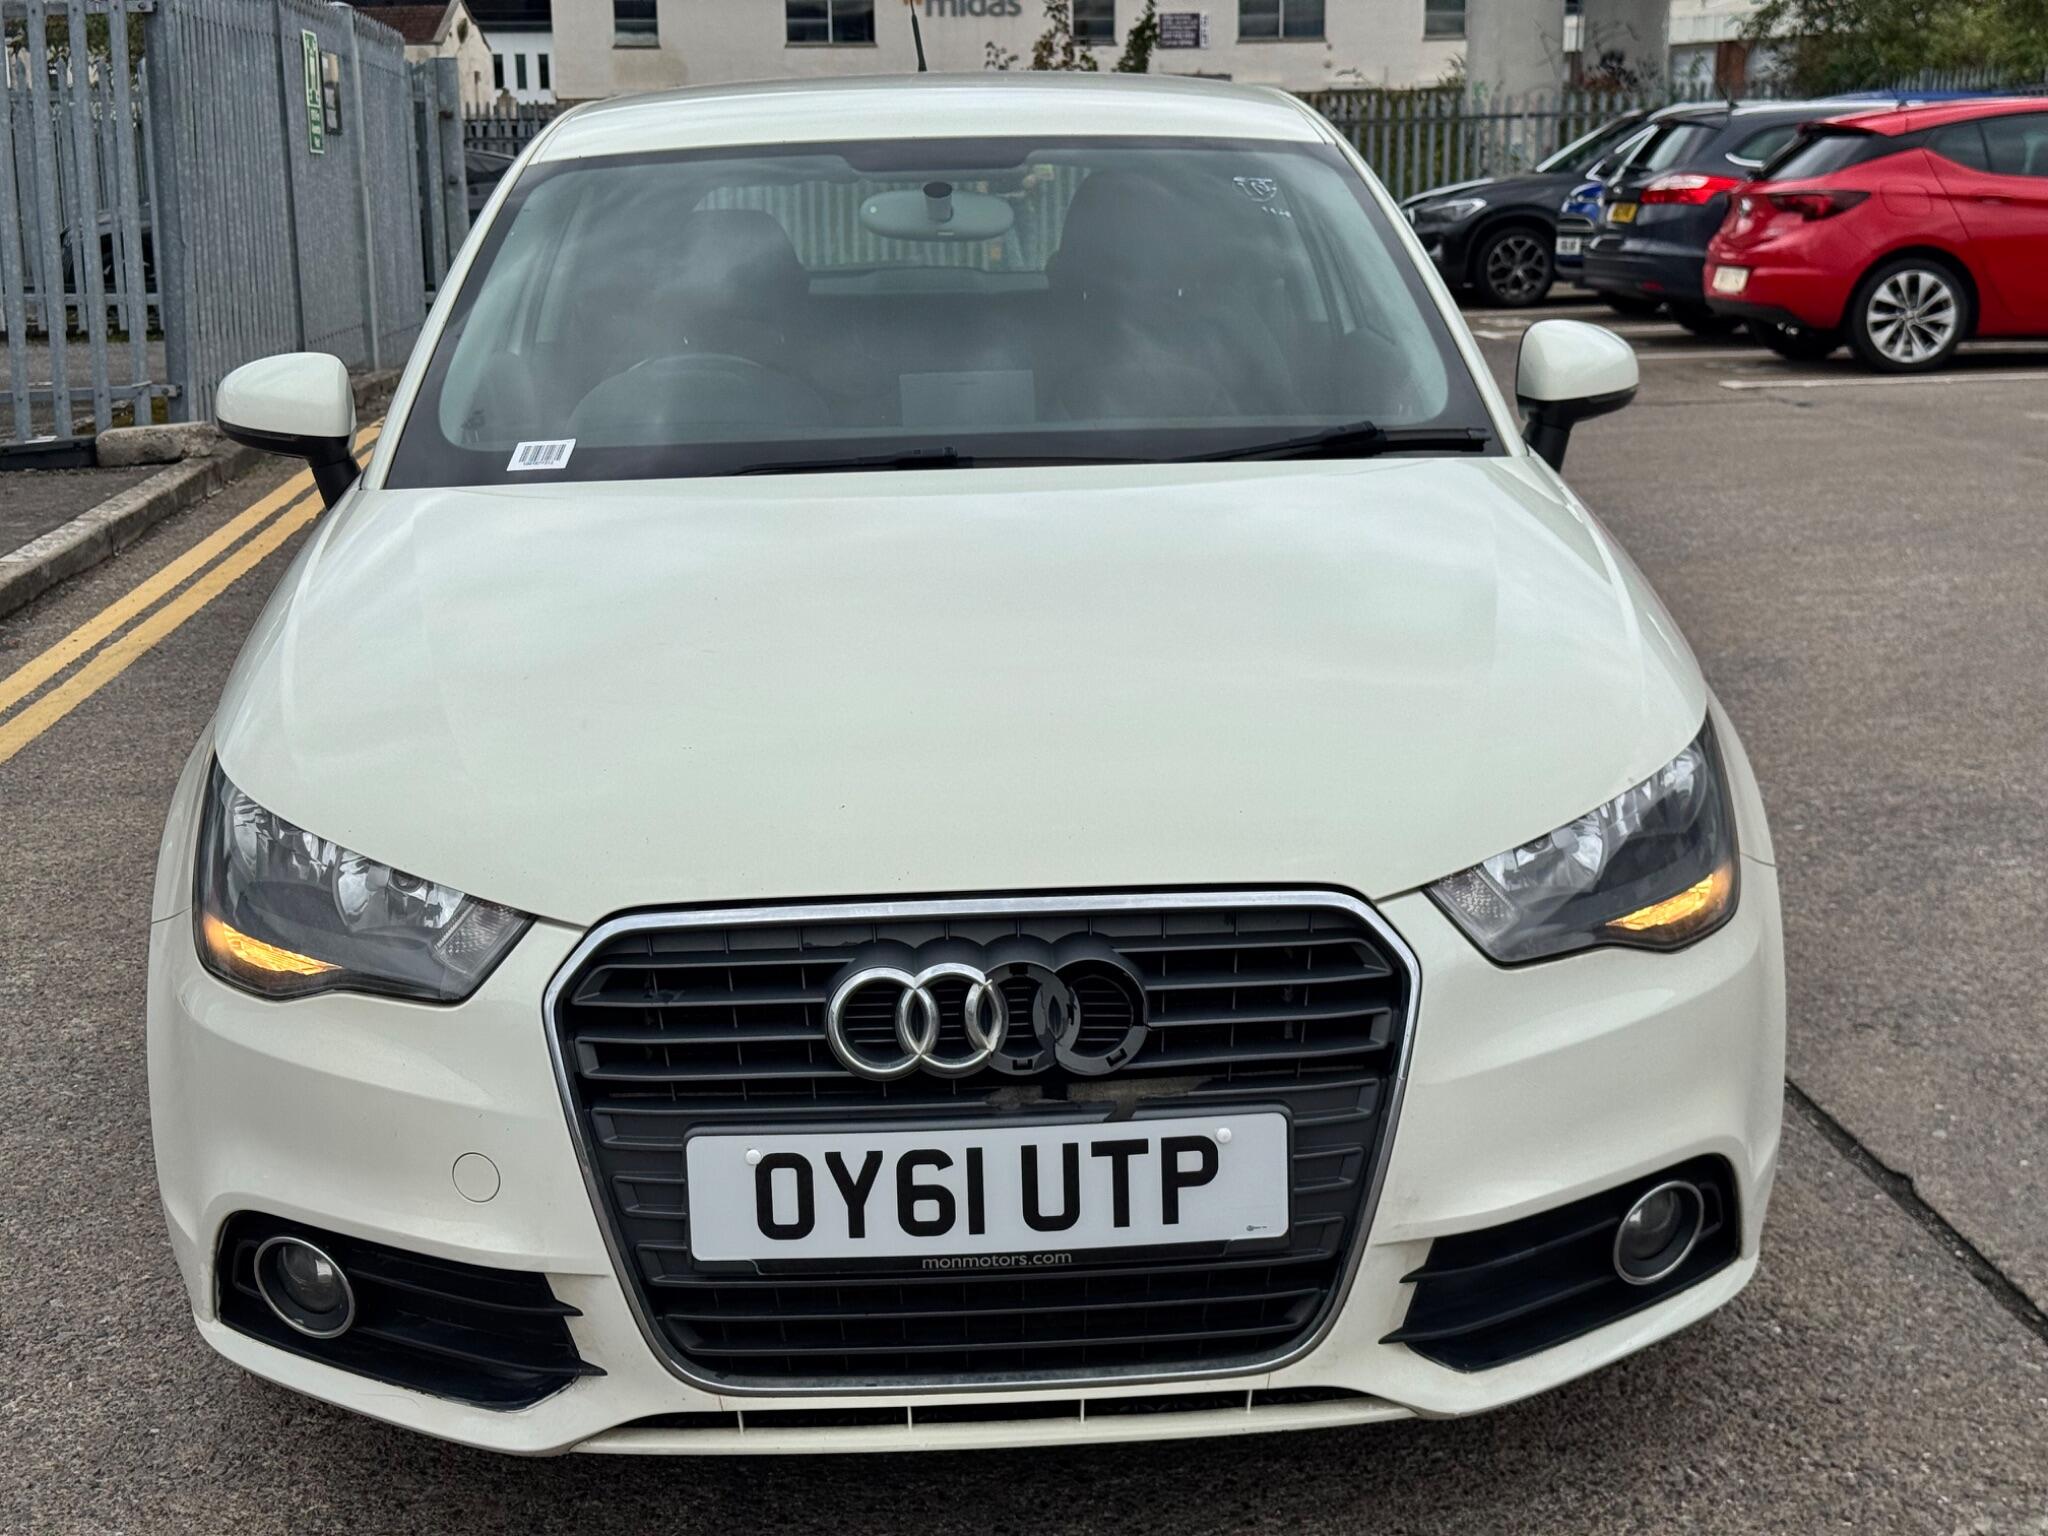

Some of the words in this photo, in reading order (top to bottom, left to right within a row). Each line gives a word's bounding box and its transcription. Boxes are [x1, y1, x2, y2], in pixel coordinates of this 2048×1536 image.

[926, 0, 1022, 17] midas
[754, 1146, 985, 1241] OY61
[1021, 1134, 1220, 1233] UTP
[922, 1252, 1073, 1270] monmotors.com
